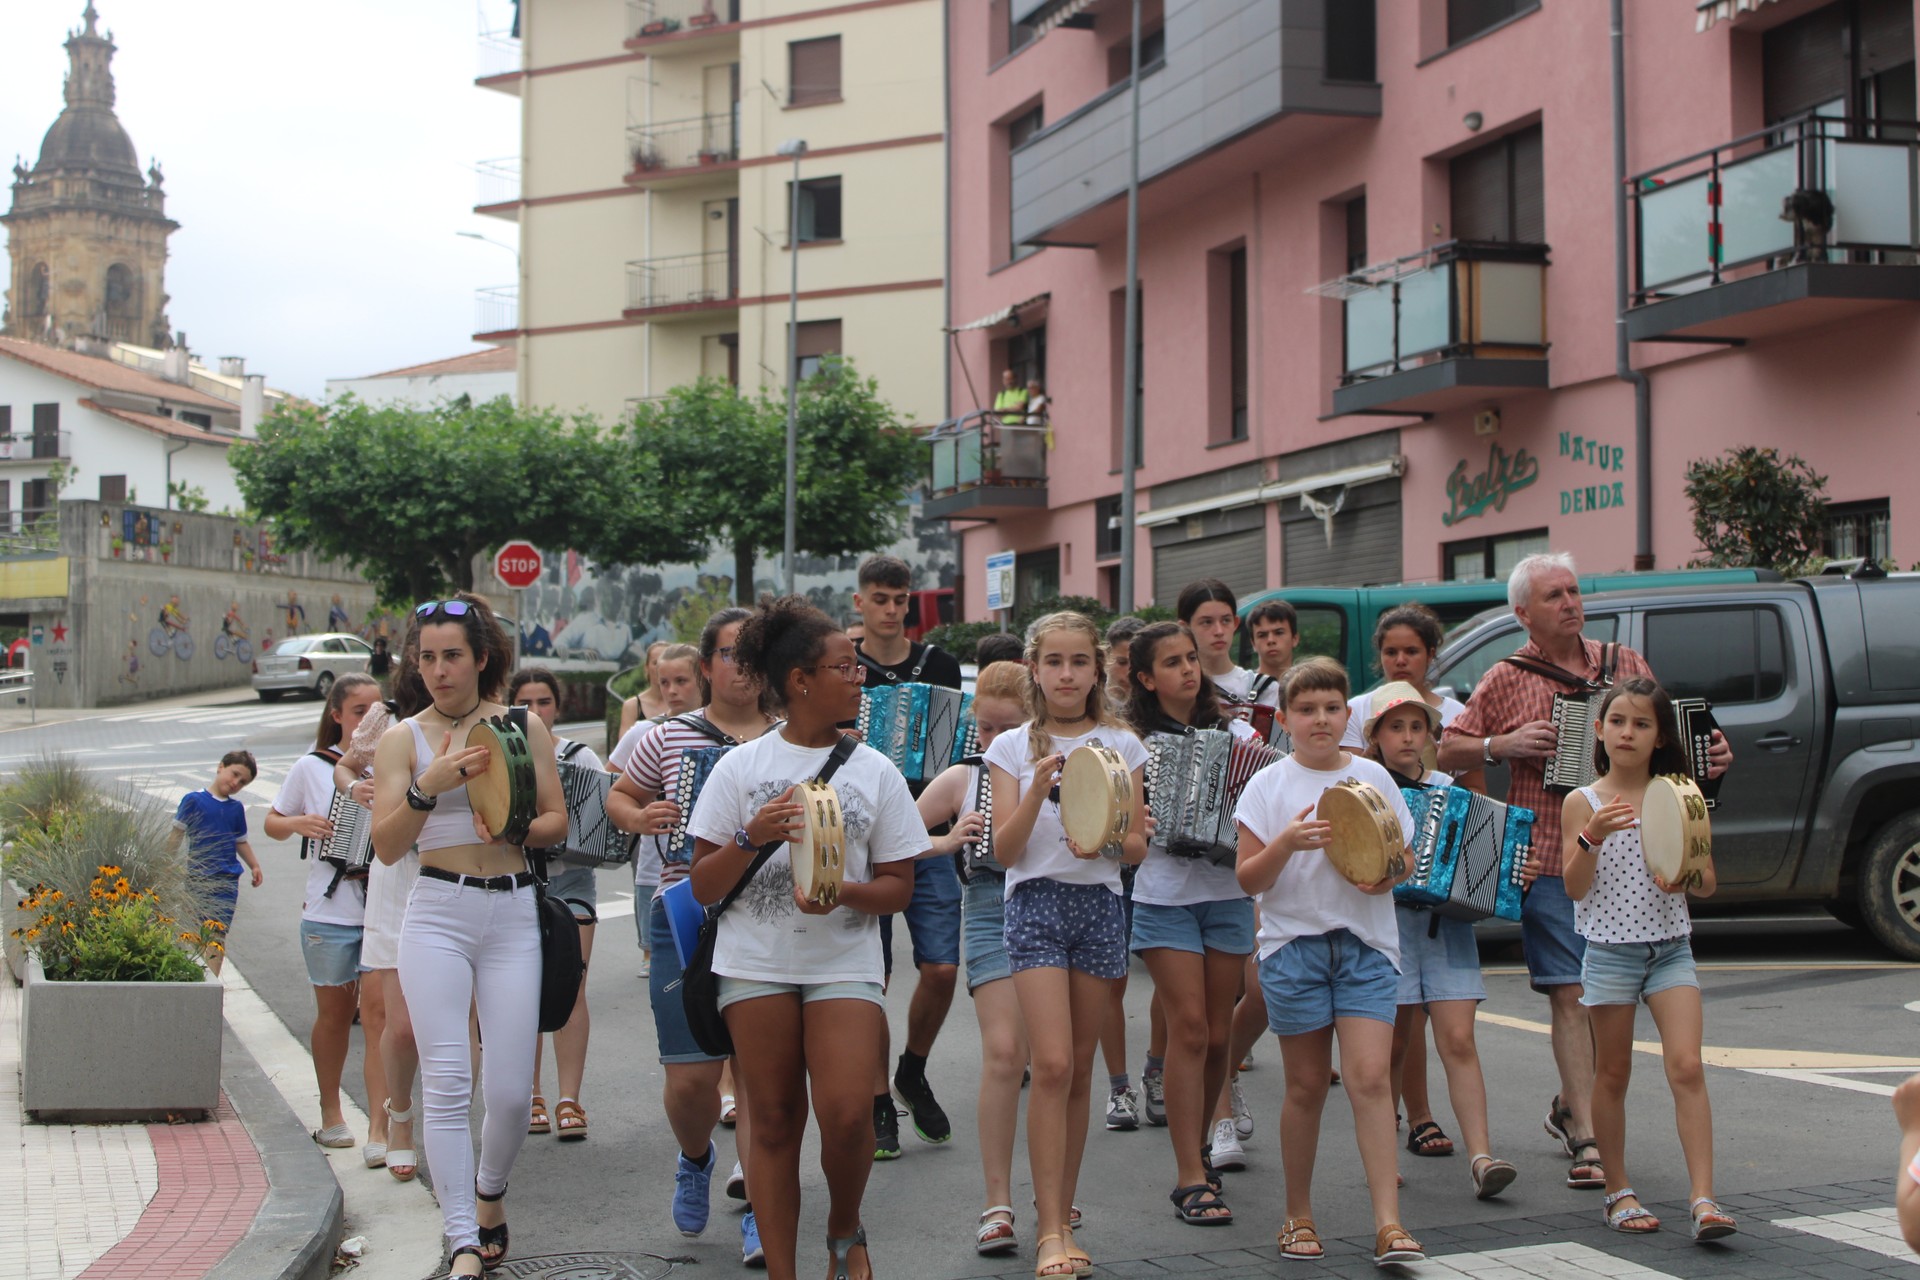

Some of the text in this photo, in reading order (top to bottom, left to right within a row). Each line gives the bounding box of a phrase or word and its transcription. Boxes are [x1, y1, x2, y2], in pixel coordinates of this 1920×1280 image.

[1559, 431, 1624, 472] NATUR
[1559, 482, 1625, 515] DENDA
[501, 559, 538, 573] STOP
